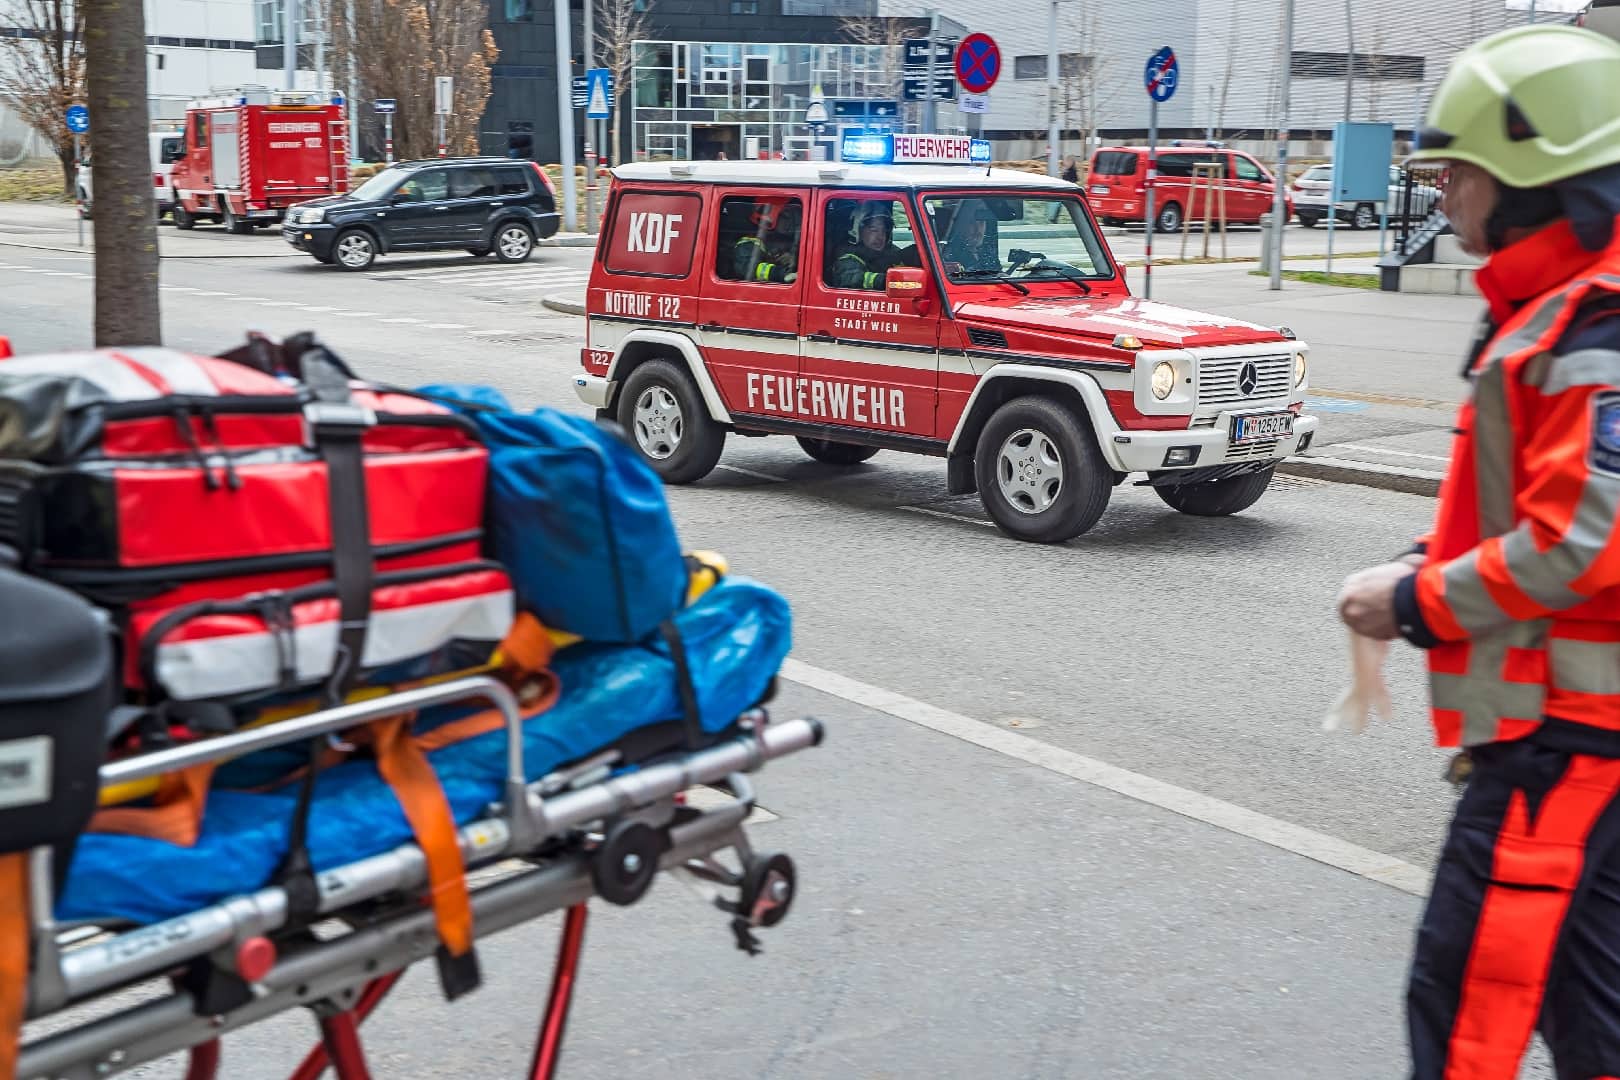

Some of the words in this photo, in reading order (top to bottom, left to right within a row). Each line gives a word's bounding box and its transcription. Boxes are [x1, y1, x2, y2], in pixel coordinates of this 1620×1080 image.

[895, 138, 970, 159] FEUERWEHR
[627, 212, 683, 254] KDF
[605, 292, 652, 316] NOTRUF
[657, 297, 681, 319] 122
[836, 298, 900, 314] FEUERWEHR
[834, 317, 868, 331] STADT
[871, 321, 898, 333] WIEN
[590, 352, 609, 366] 122
[747, 372, 906, 427] FEUERWEHR
